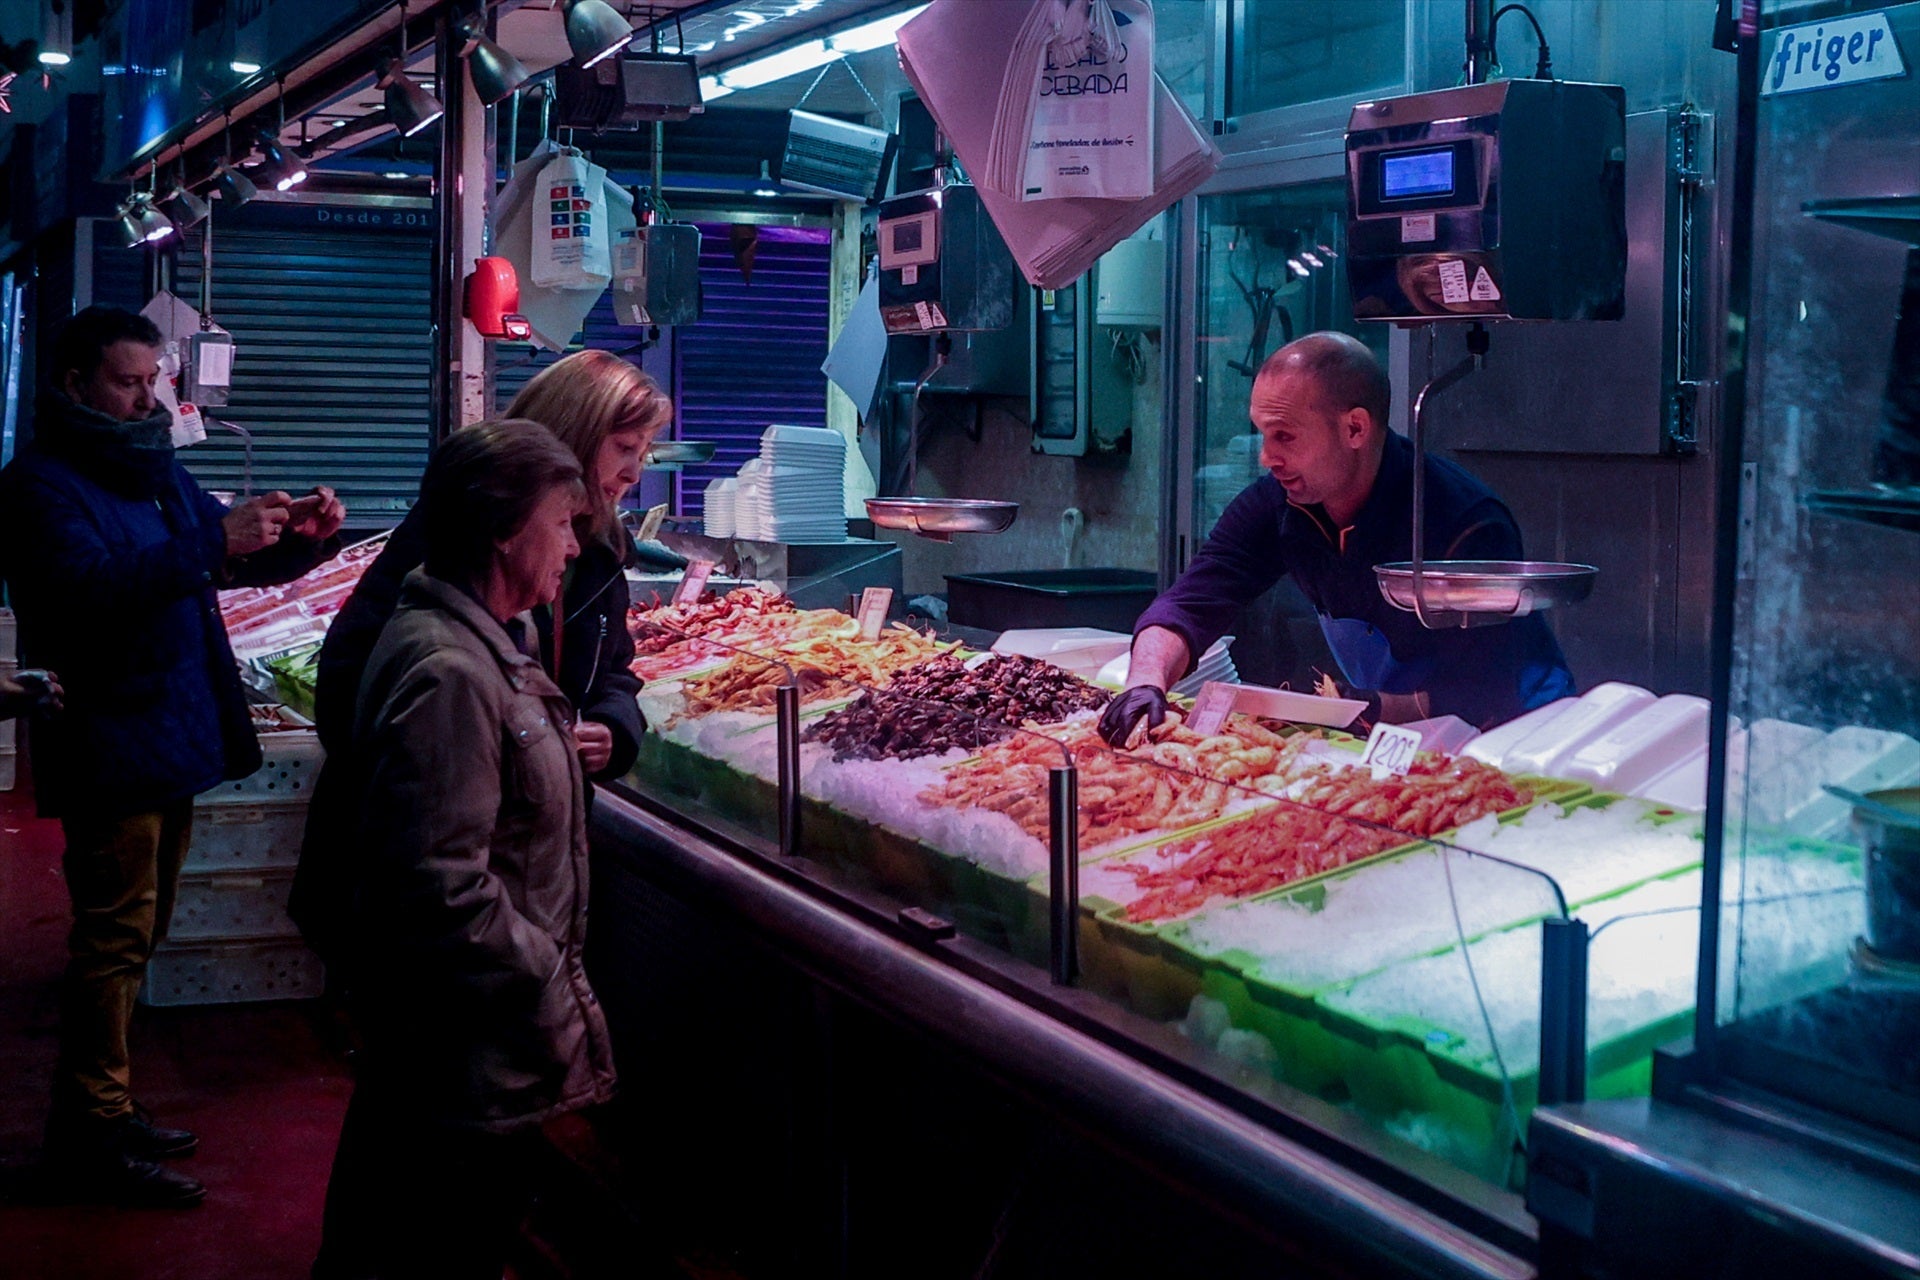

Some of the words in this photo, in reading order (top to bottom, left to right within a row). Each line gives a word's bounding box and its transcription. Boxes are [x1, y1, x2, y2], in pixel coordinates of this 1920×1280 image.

[1773, 27, 1884, 90] friger
[1040, 73, 1128, 97] CEBADA
[1091, 138, 1101, 147] de
[317, 209, 382, 225] Desde
